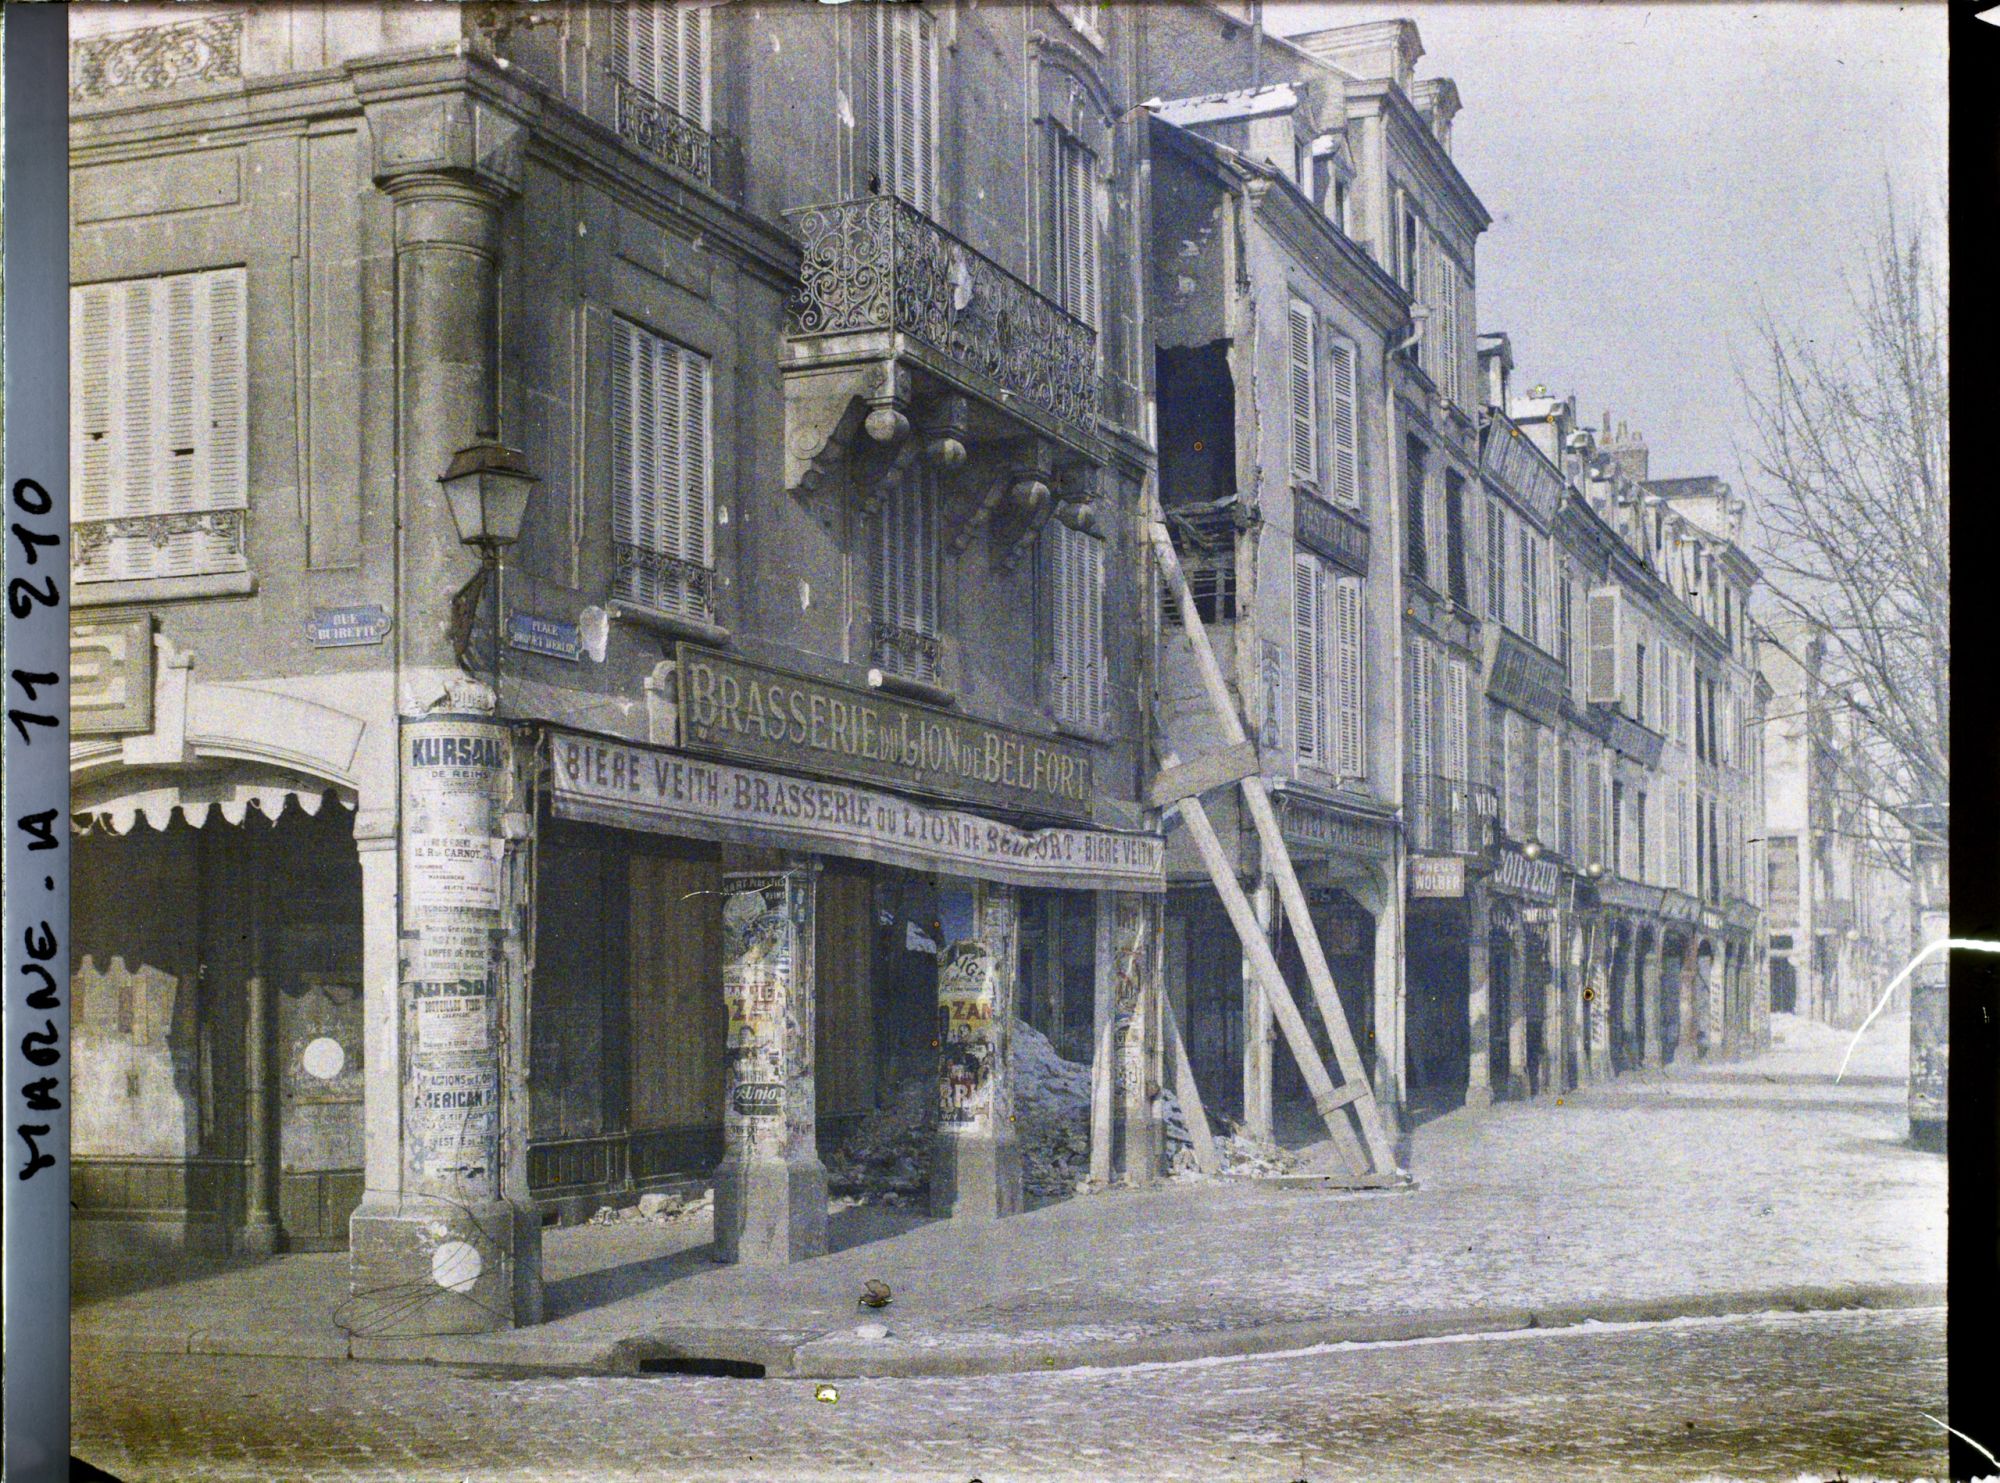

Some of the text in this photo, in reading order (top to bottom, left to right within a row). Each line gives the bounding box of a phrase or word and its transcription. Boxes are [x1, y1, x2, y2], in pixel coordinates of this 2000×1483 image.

[332, 612, 358, 626] RUE
[531, 620, 560, 637] PLACE
[690, 662, 878, 761] BRASSERIE
[901, 711, 960, 774] LION
[983, 731, 1089, 800] BELFORT
[431, 770, 446, 779] DE
[566, 744, 641, 791] BIERE
[654, 756, 719, 807] VEITH
[734, 773, 872, 826] BRASSERIE
[904, 806, 960, 850] LION
[17, 807, 60, 851] A
[17, 920, 62, 1181] MARNE
